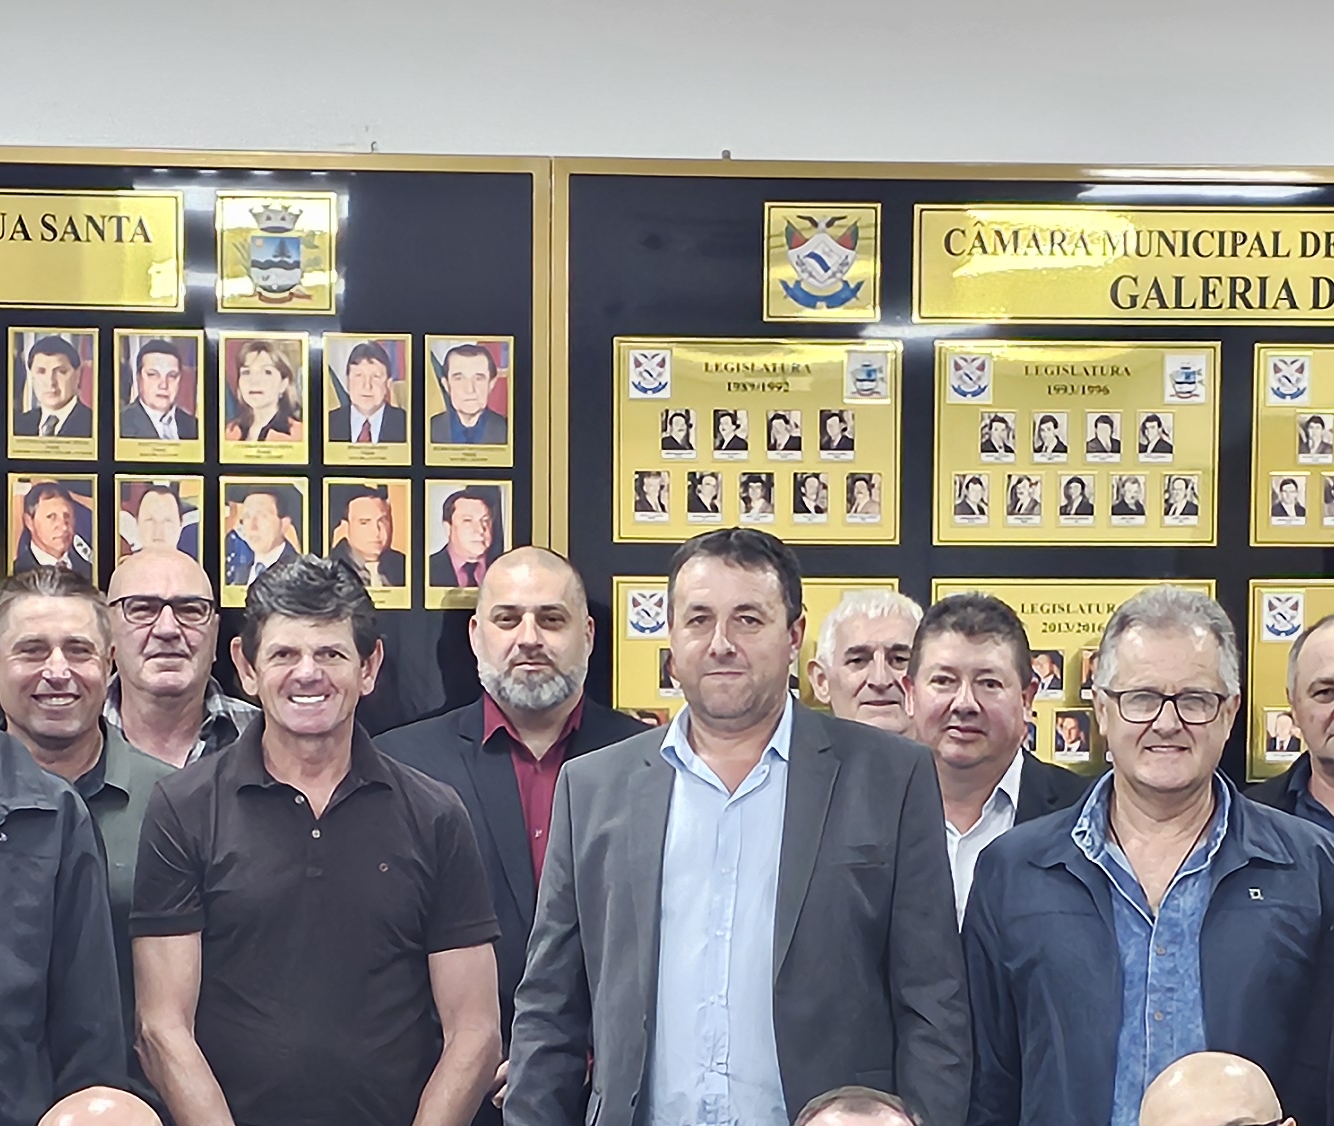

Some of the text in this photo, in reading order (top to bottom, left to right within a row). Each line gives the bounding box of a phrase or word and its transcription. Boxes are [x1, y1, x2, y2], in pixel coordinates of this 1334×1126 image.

[40, 213, 152, 244] SANTA
[944, 221, 1089, 257] CÂMARA
[1101, 229, 1291, 259] MUNICIPAL
[1109, 274, 1301, 310] GALERIA
[703, 361, 812, 375] LEGISLATURA
[1024, 364, 1131, 378] LEGISLATURA
[1021, 602, 1115, 615] LEGISLATUR
